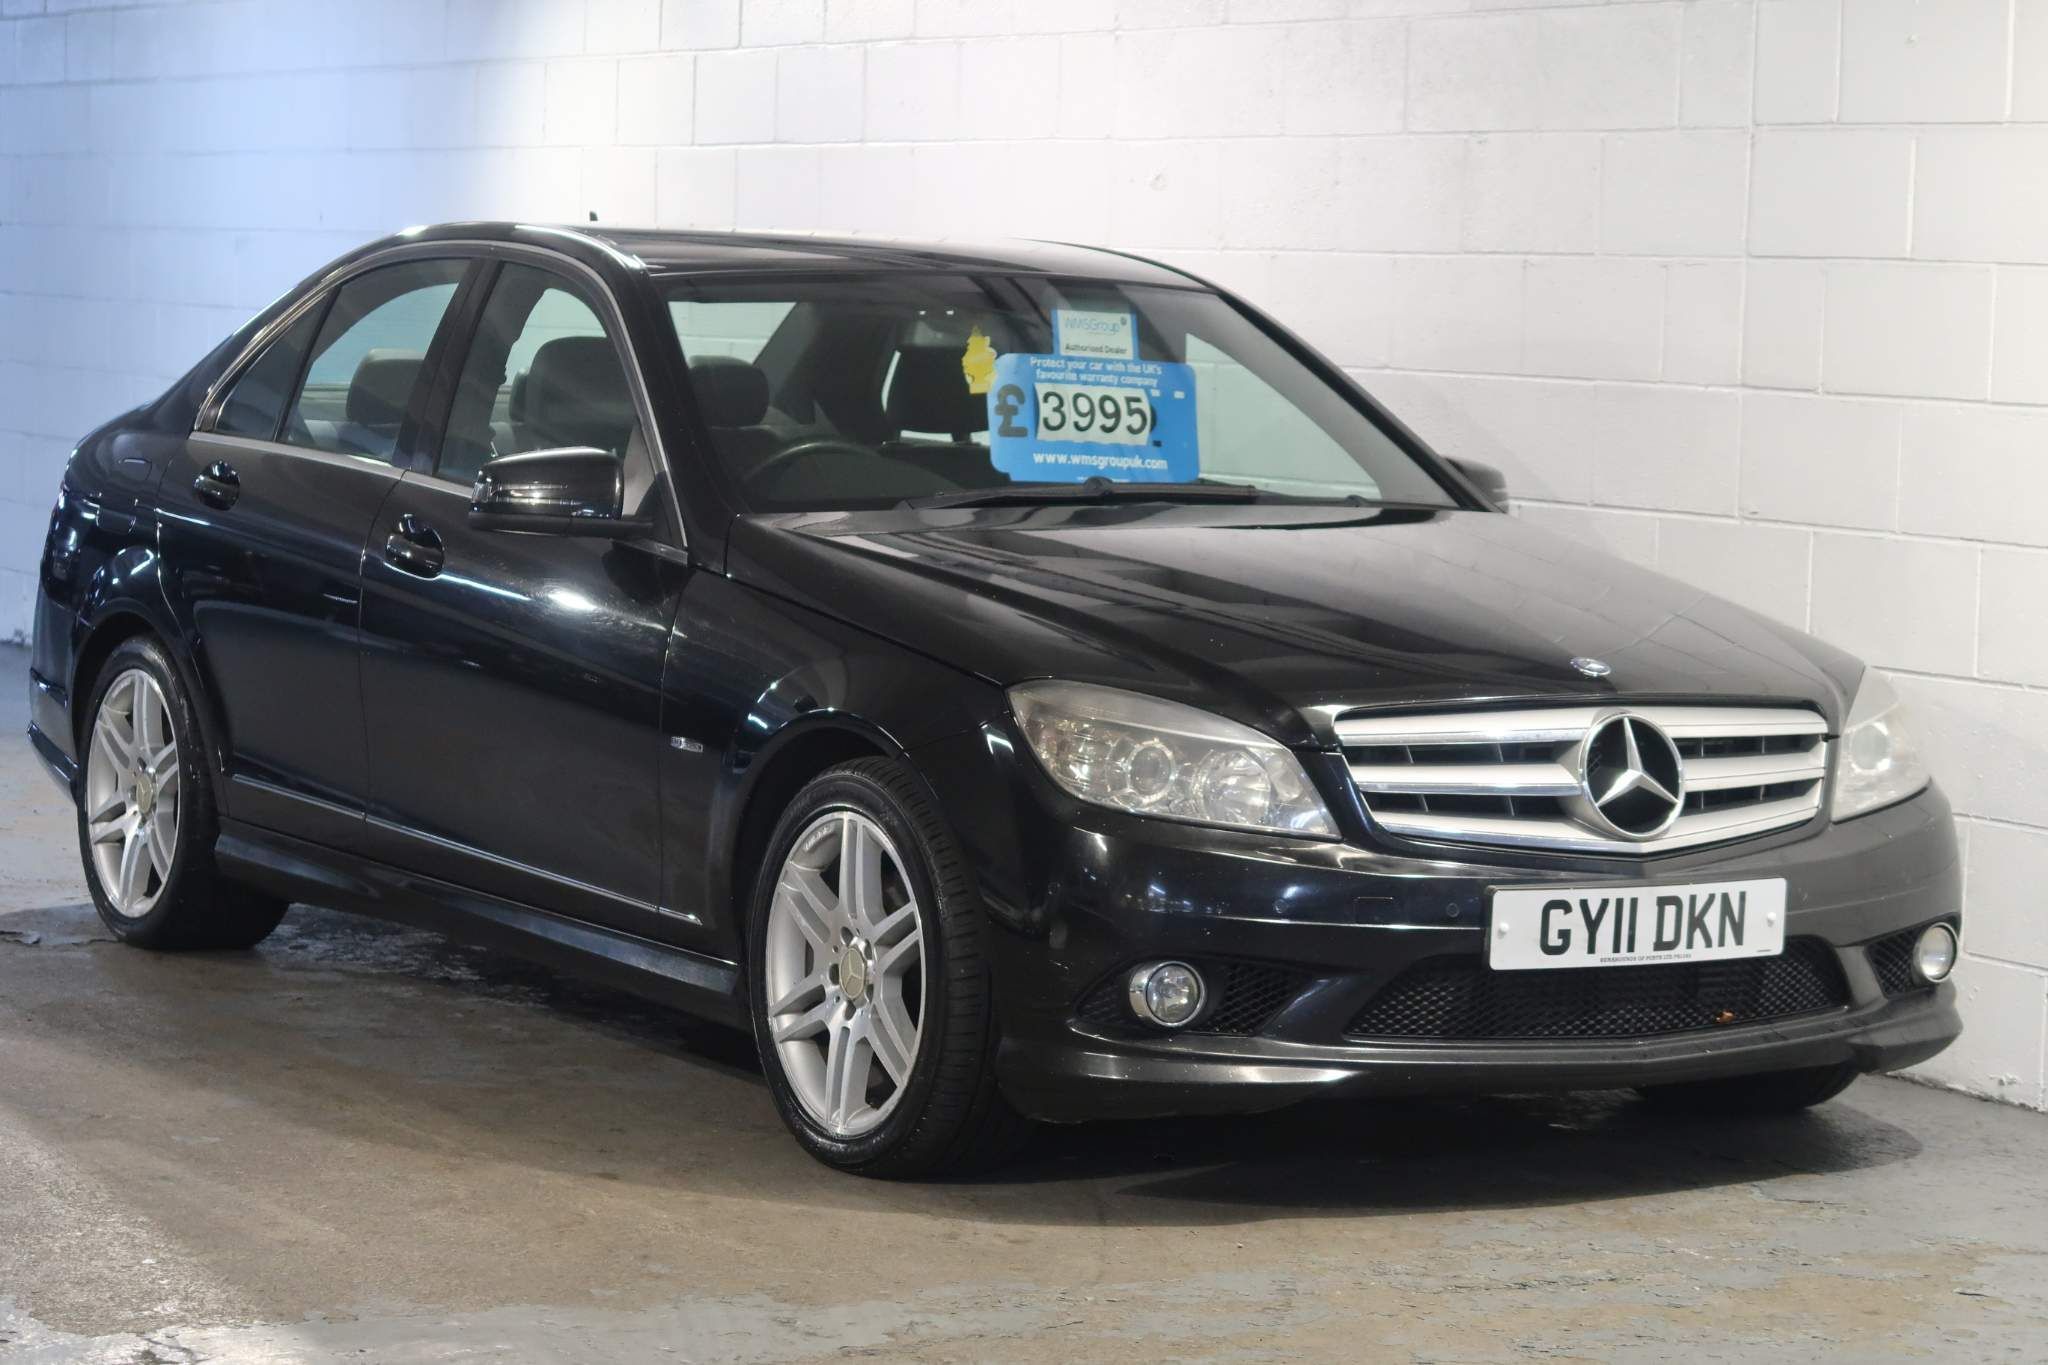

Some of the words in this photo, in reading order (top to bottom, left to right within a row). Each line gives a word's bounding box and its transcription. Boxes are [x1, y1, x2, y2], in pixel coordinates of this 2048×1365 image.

[1105, 345, 1127, 354] Dealer
[1030, 357, 1065, 368] Protect
[1067, 361, 1087, 370] your
[1089, 362, 1103, 370] car
[1106, 361, 1125, 372] with
[1127, 362, 1141, 373] the
[1036, 369, 1077, 381] favourite
[1079, 373, 1118, 385] warranty
[1120, 376, 1158, 388] company
[994, 383, 1028, 438] £
[1042, 391, 1147, 436] 3995
[1033, 453, 1168, 470] www.wmsgroupuk.com
[1539, 897, 1639, 955] GY11
[1653, 891, 1747, 951] DKN
